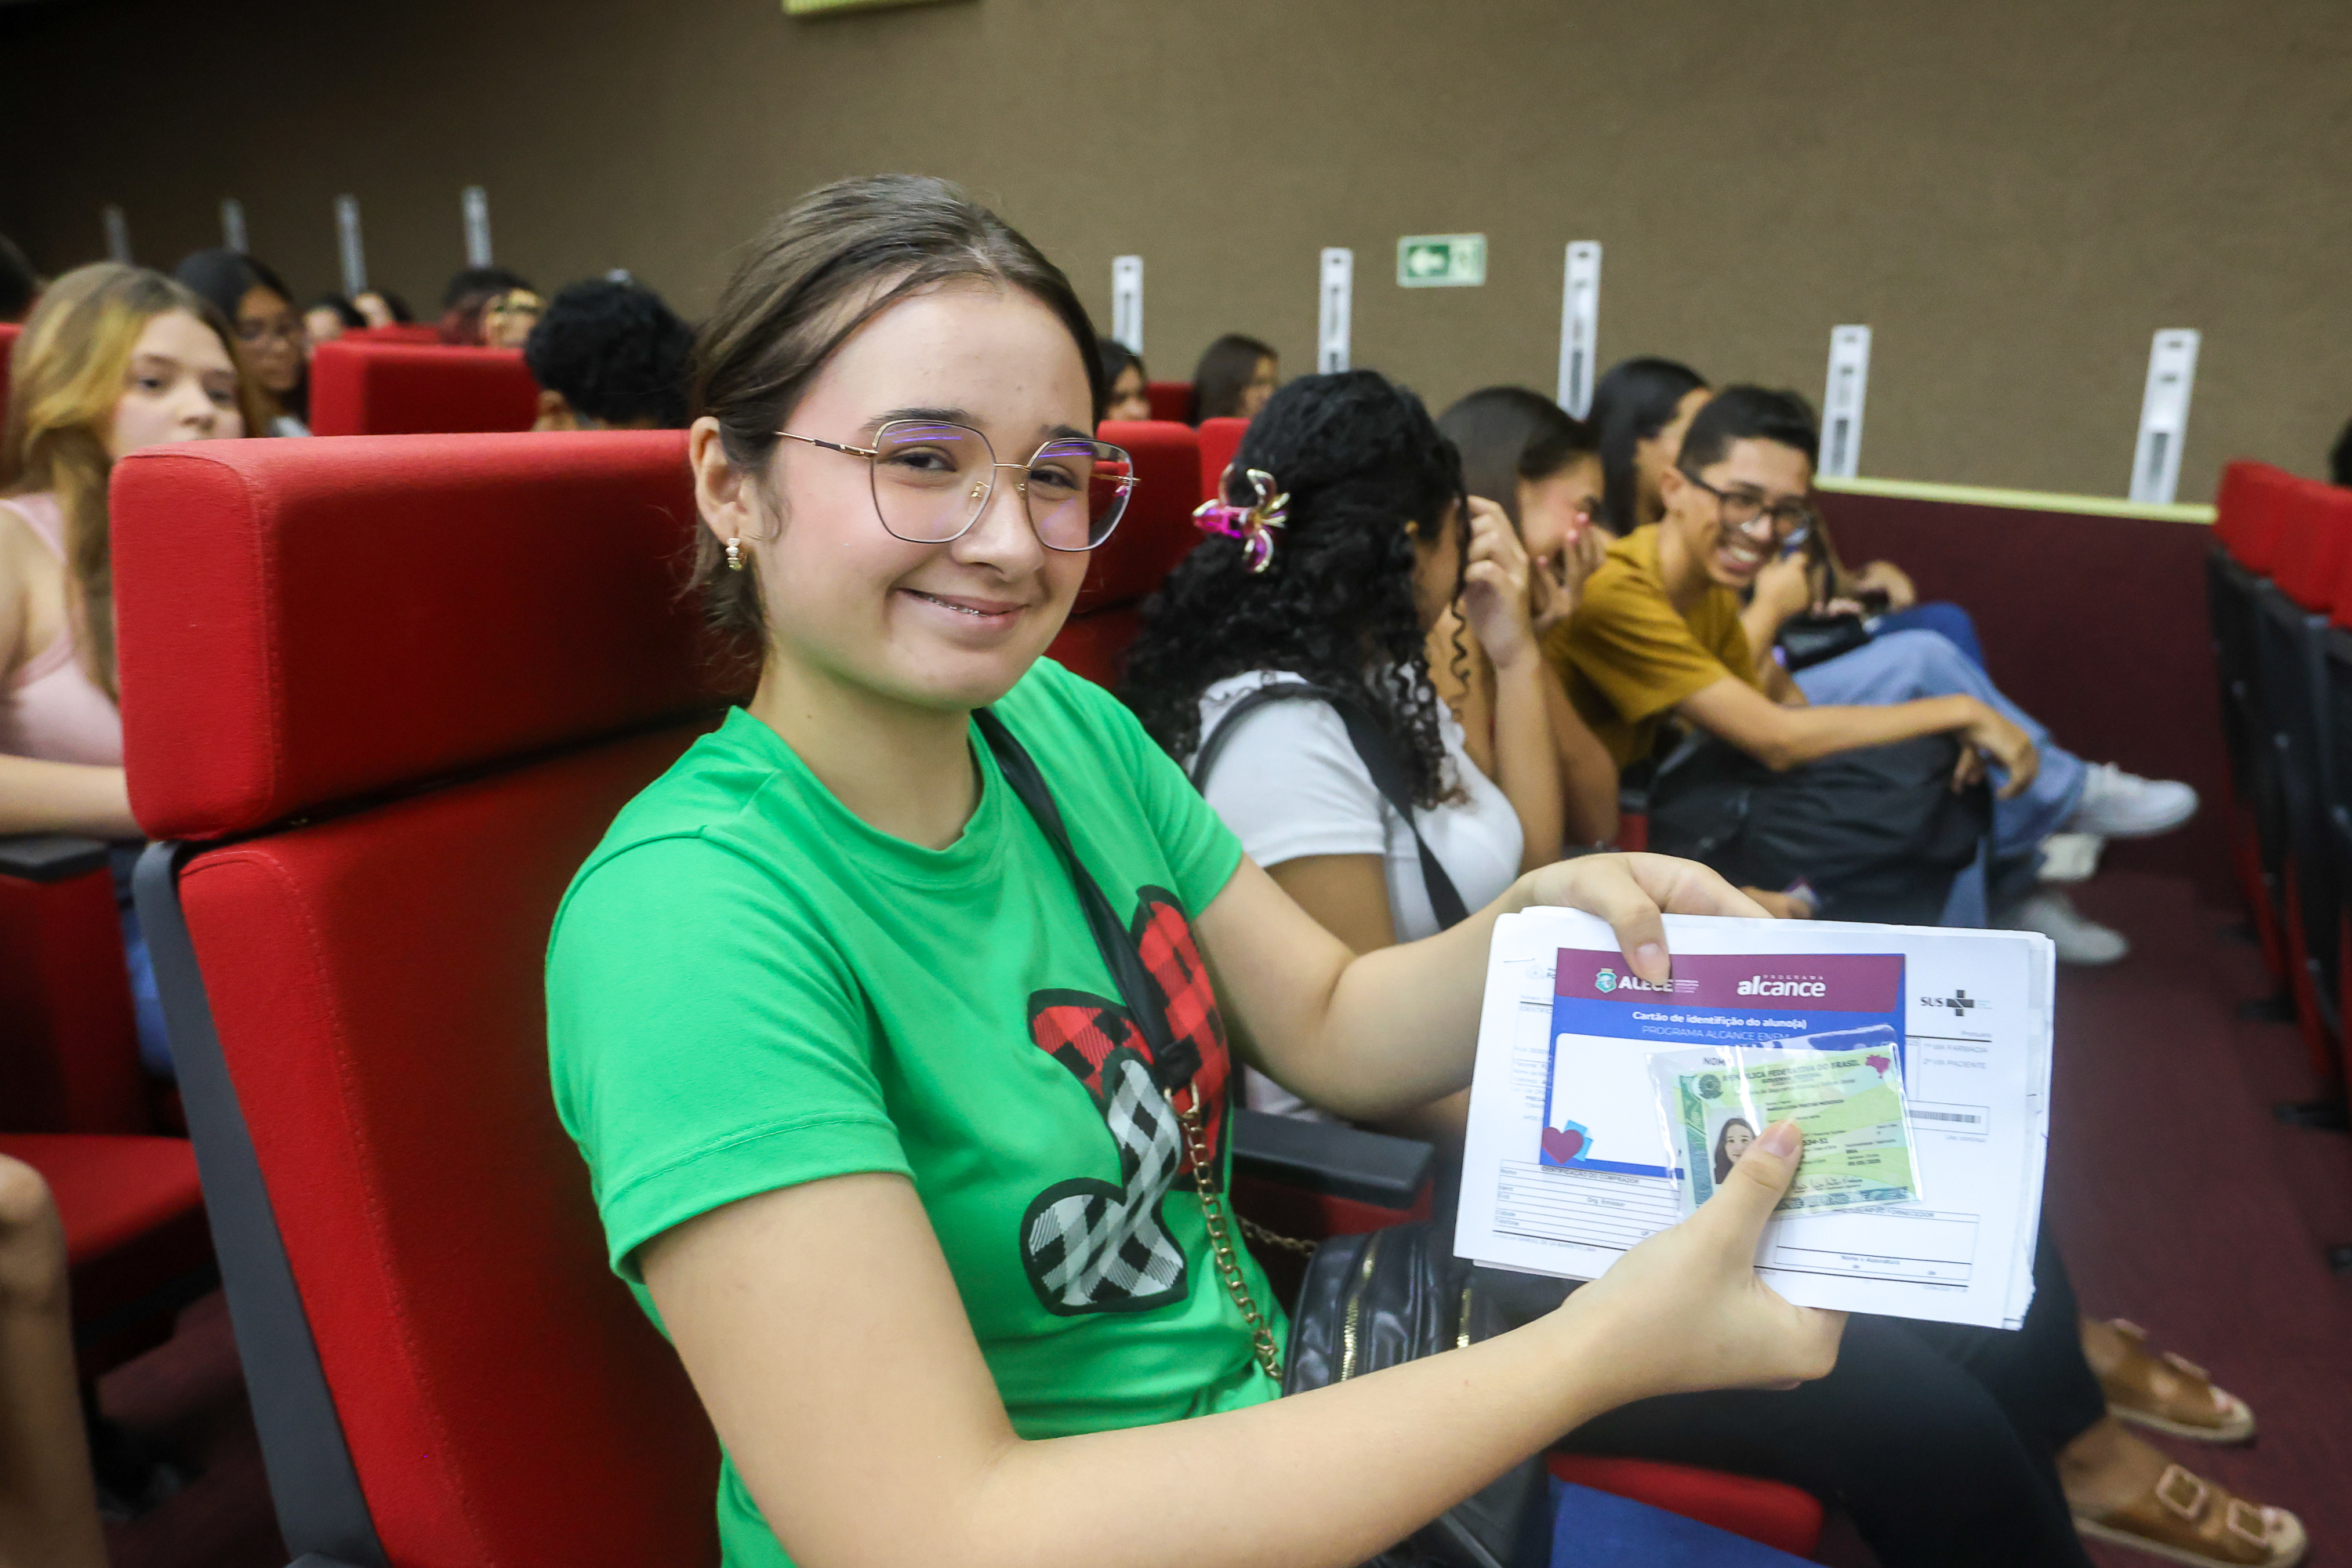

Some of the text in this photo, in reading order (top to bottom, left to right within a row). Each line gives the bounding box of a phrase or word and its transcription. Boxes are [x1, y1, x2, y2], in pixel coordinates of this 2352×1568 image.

[1737, 975, 1827, 997] alcance
[1920, 996, 1944, 1007] SUS
[1632, 1011, 1669, 1022] Cartão
[1670, 1014, 1685, 1022] de
[1745, 1017, 1761, 1026] do
[1762, 1018, 1807, 1029] aluno(a)
[1642, 1025, 1704, 1037] PROGRAMA
[1705, 1029, 1755, 1040] ALCANCE
